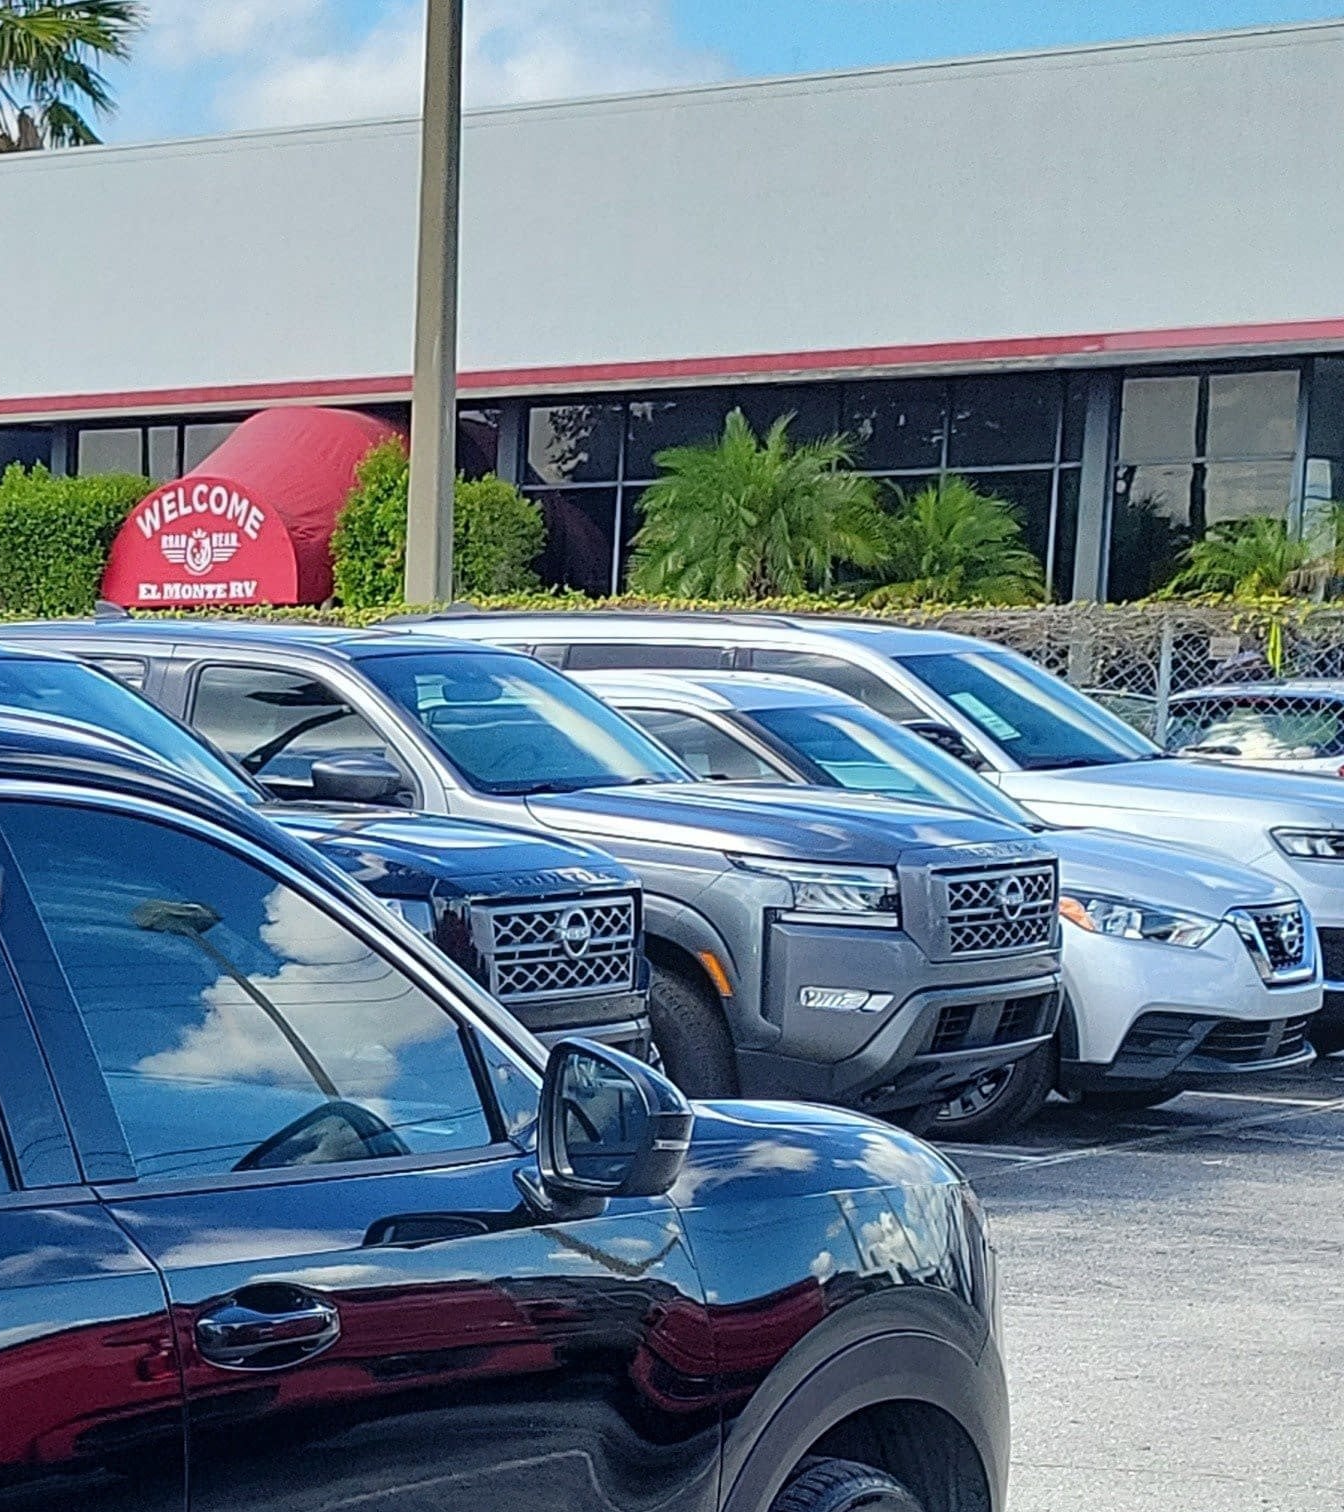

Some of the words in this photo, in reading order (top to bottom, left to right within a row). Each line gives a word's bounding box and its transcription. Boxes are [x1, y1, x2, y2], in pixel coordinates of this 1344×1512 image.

[135, 484, 265, 540] WELCOME
[138, 583, 162, 600] EL
[162, 582, 227, 600] MONTE
[229, 580, 258, 599] RV
